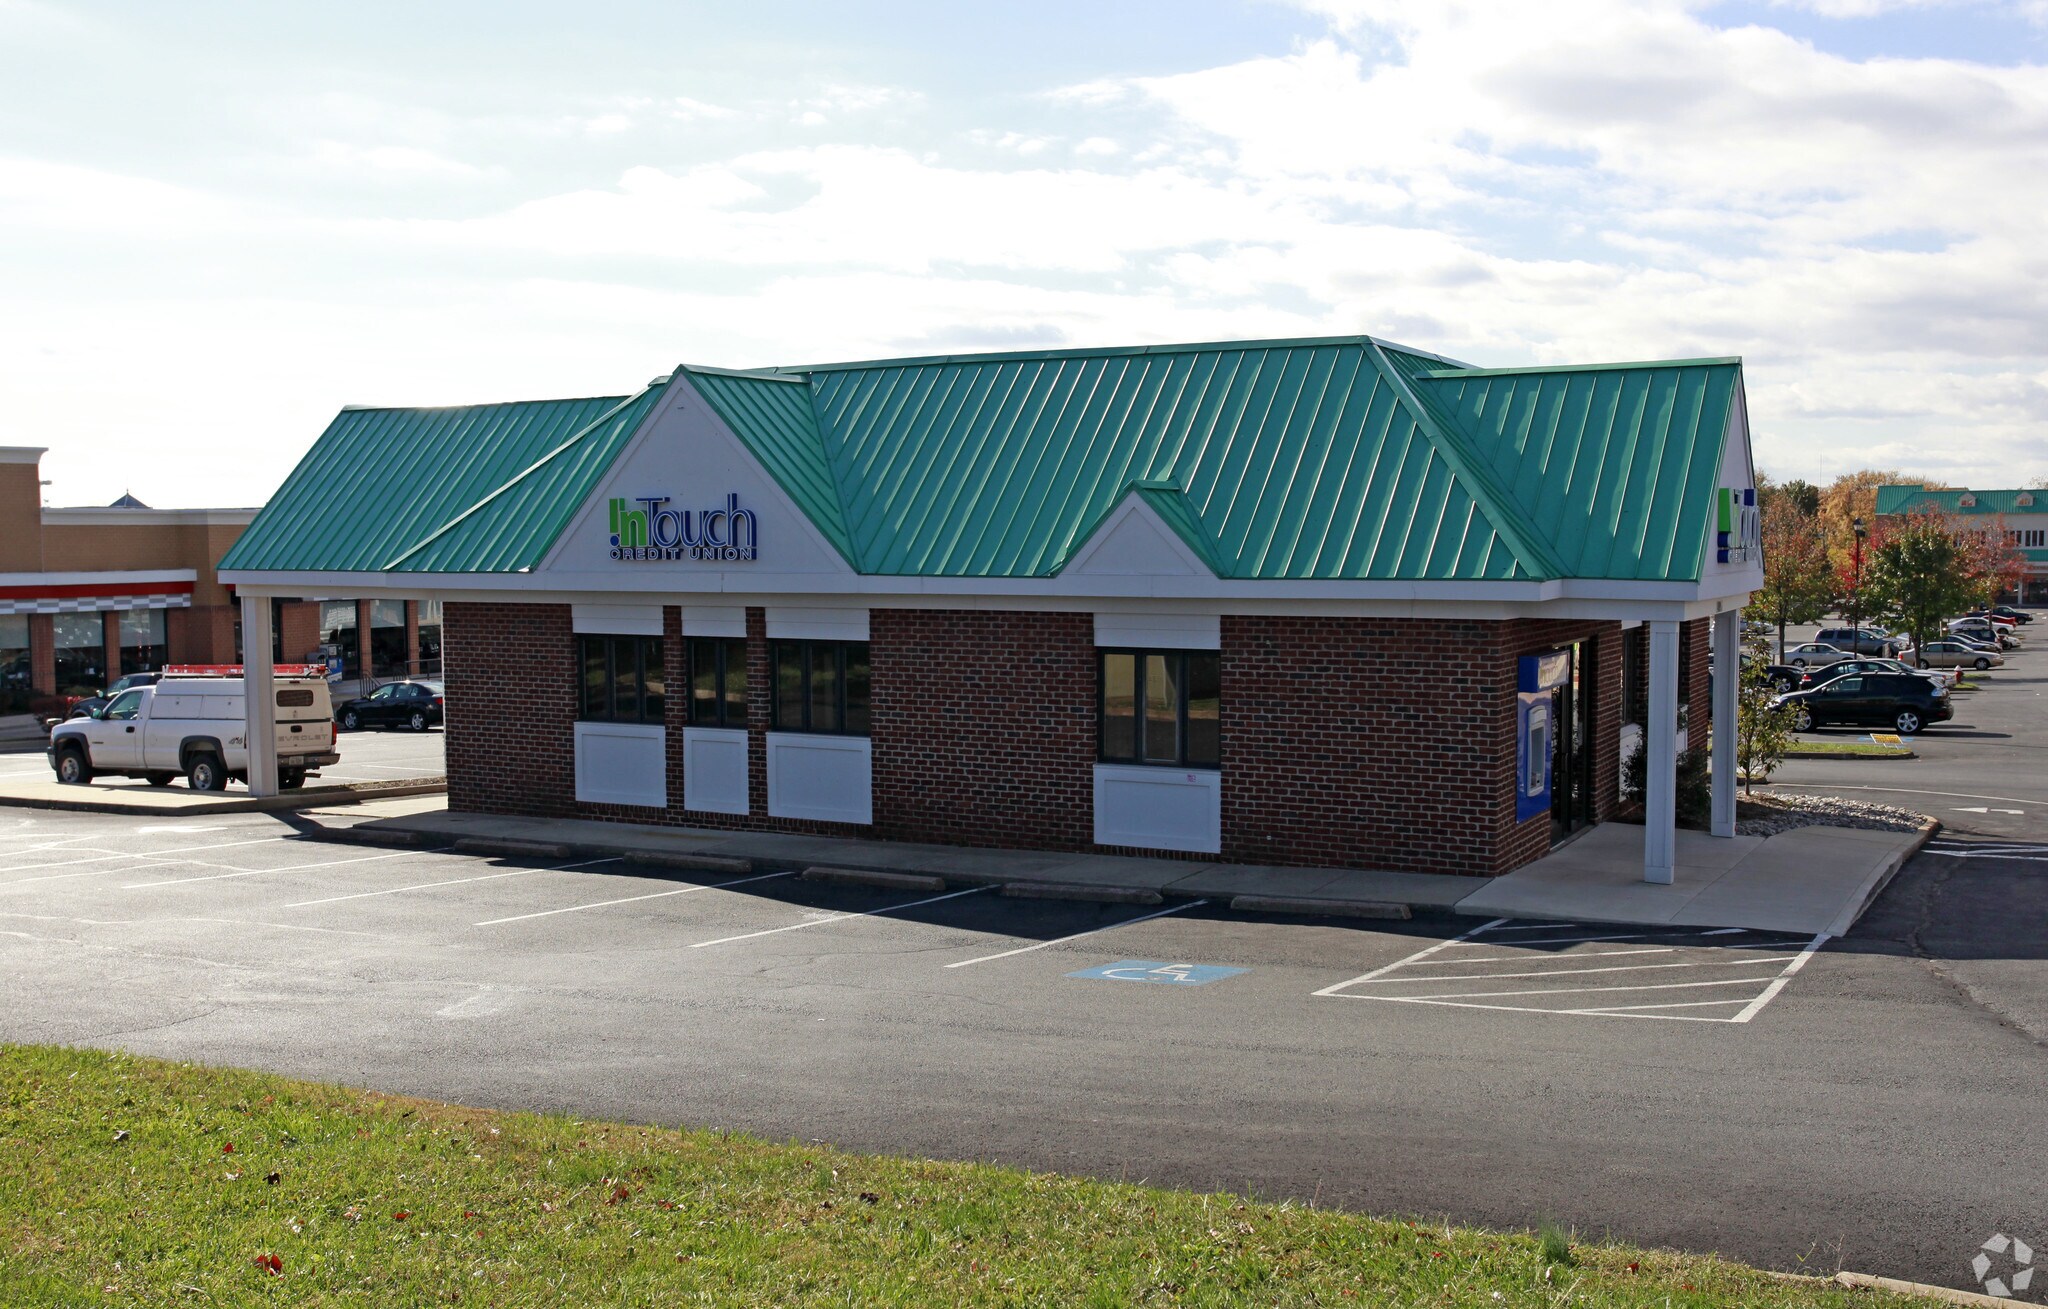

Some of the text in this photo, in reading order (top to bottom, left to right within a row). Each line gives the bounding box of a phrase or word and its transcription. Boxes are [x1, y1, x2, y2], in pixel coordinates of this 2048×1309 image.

[609, 548, 756, 560] CREDIT UNION
[277, 734, 328, 742] EVROLET
